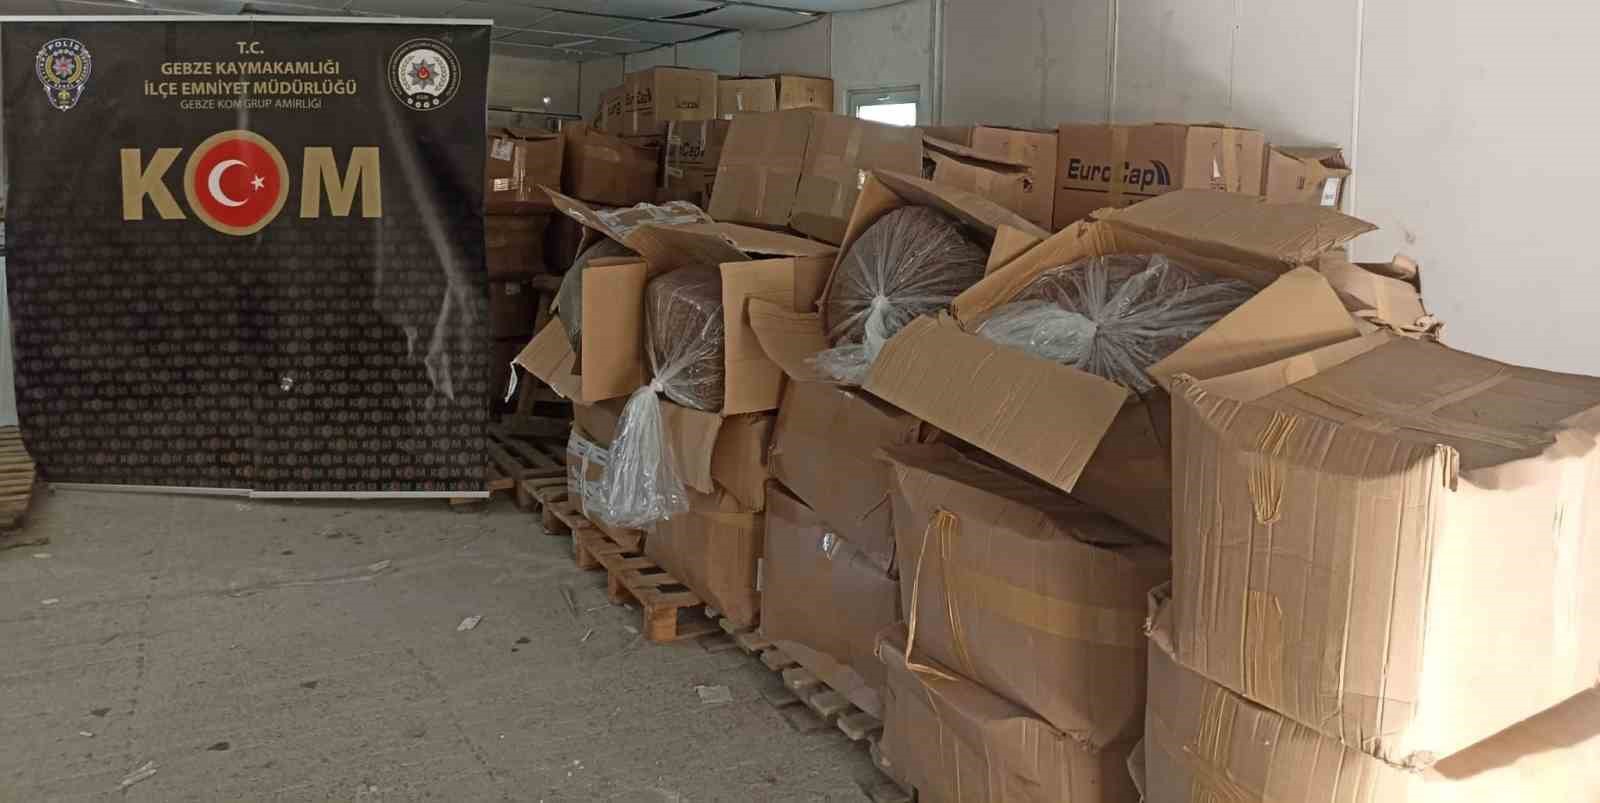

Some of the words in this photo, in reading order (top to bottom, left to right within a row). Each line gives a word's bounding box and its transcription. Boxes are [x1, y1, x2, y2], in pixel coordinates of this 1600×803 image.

[236, 41, 264, 54] T.C.
[161, 62, 213, 75] GEBZE
[216, 59, 340, 75] KAYMAKAMLIĞI
[144, 80, 178, 99] İLÇE
[182, 80, 250, 95] EMNİYET
[254, 79, 357, 95] MÜDÜRLÜĞÜ
[180, 98, 216, 109] GEBZE
[244, 98, 272, 109] GRUP
